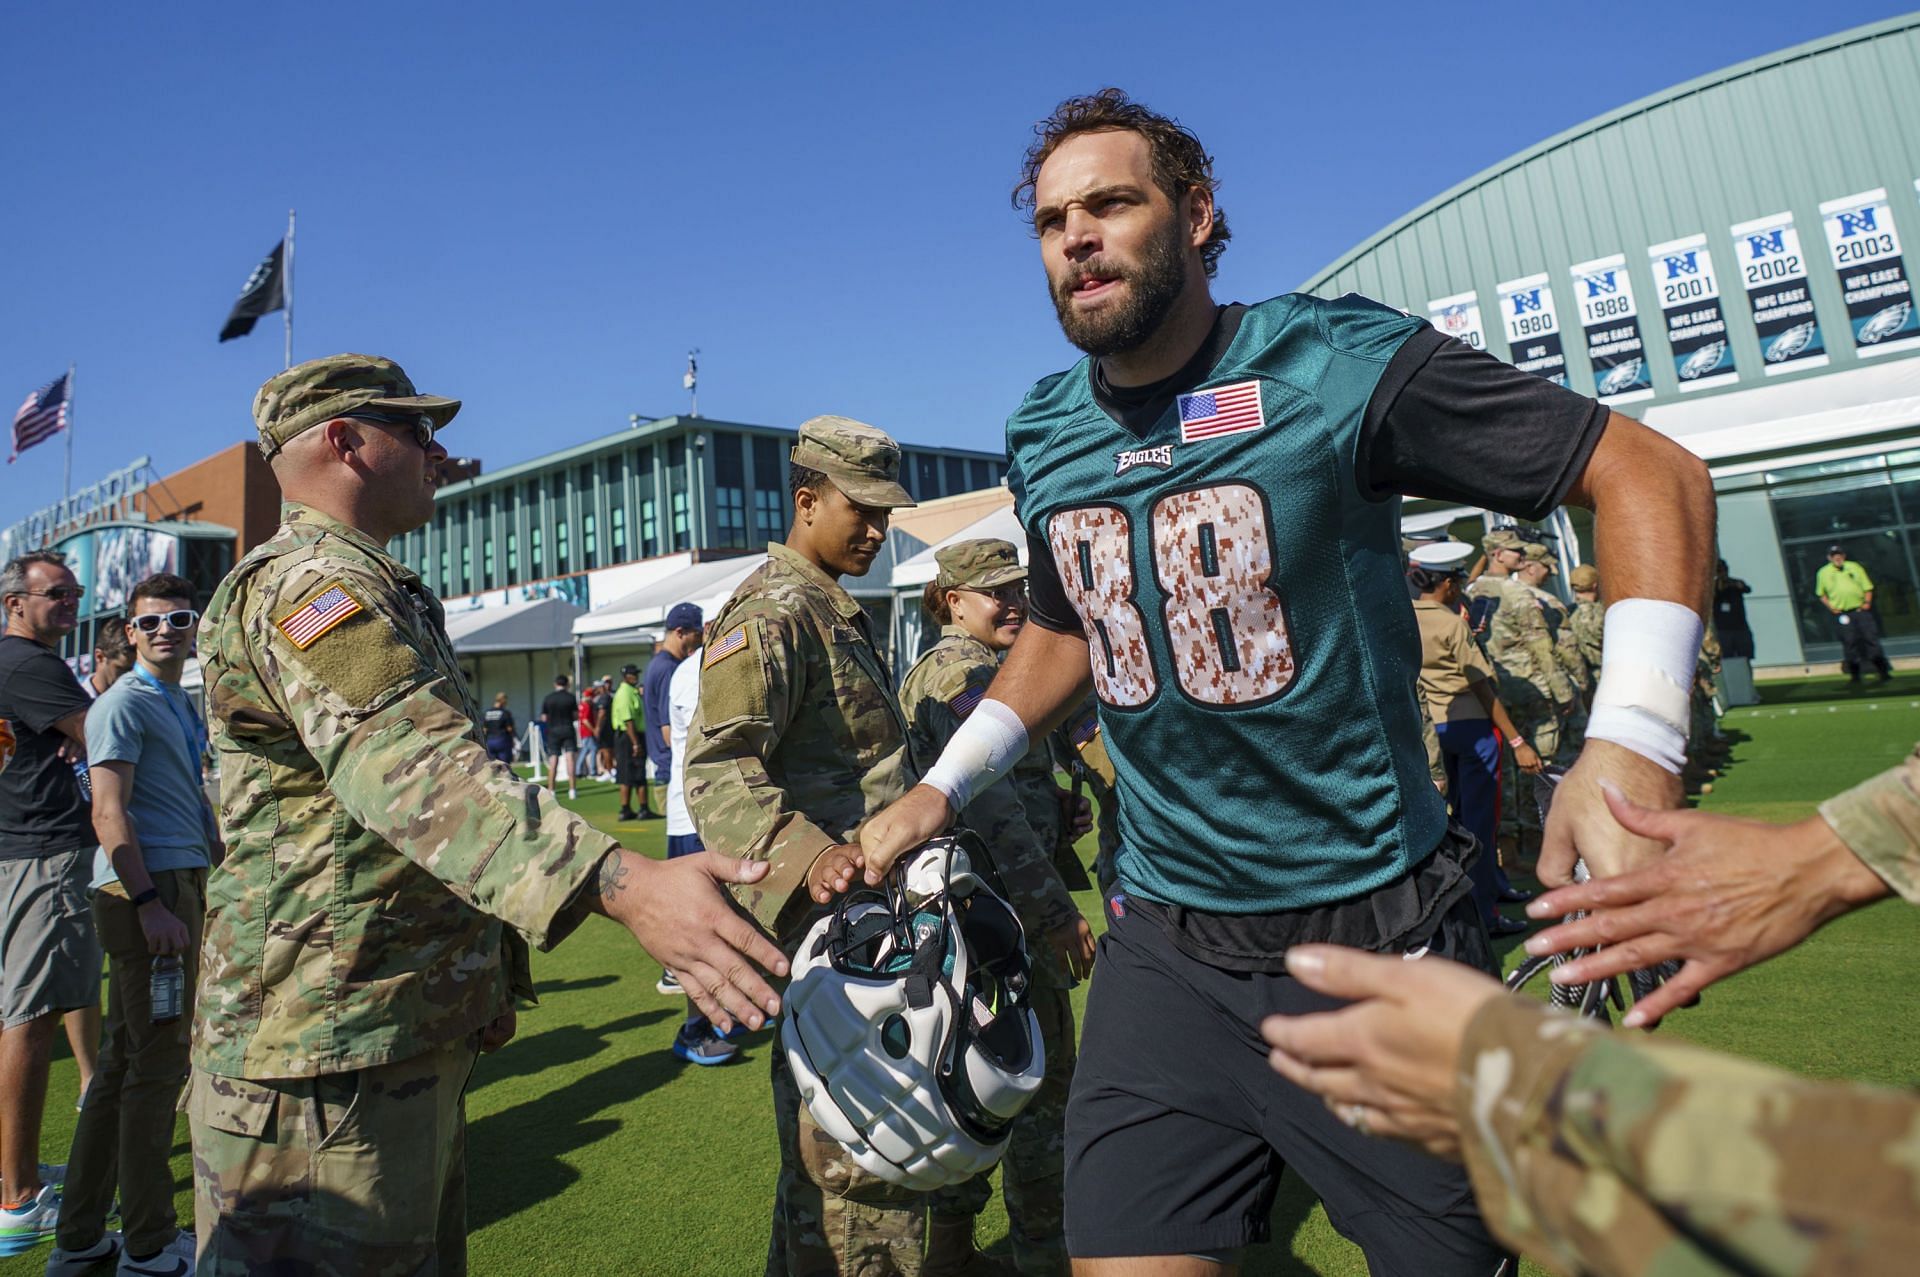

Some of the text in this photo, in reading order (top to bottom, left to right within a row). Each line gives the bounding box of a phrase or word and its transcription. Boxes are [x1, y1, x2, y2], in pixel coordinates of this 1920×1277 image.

[1836, 234, 1893, 262] 2003
[1746, 256, 1801, 283] 2002
[1870, 267, 1900, 285] EAST
[1664, 277, 1713, 302] 2001
[1777, 288, 1805, 305] EAST
[1844, 280, 1909, 304] CHAMPIONS
[1586, 296, 1629, 320] 1988
[1691, 307, 1717, 324] EAST
[1753, 300, 1814, 323] CHAMPIONS
[1511, 313, 1552, 337] 1980
[1669, 320, 1725, 342] CHAMPIONS
[1589, 337, 1642, 359] CHAMPIONS
[1114, 444, 1174, 475] EAGLES
[1047, 478, 1300, 710] 88
